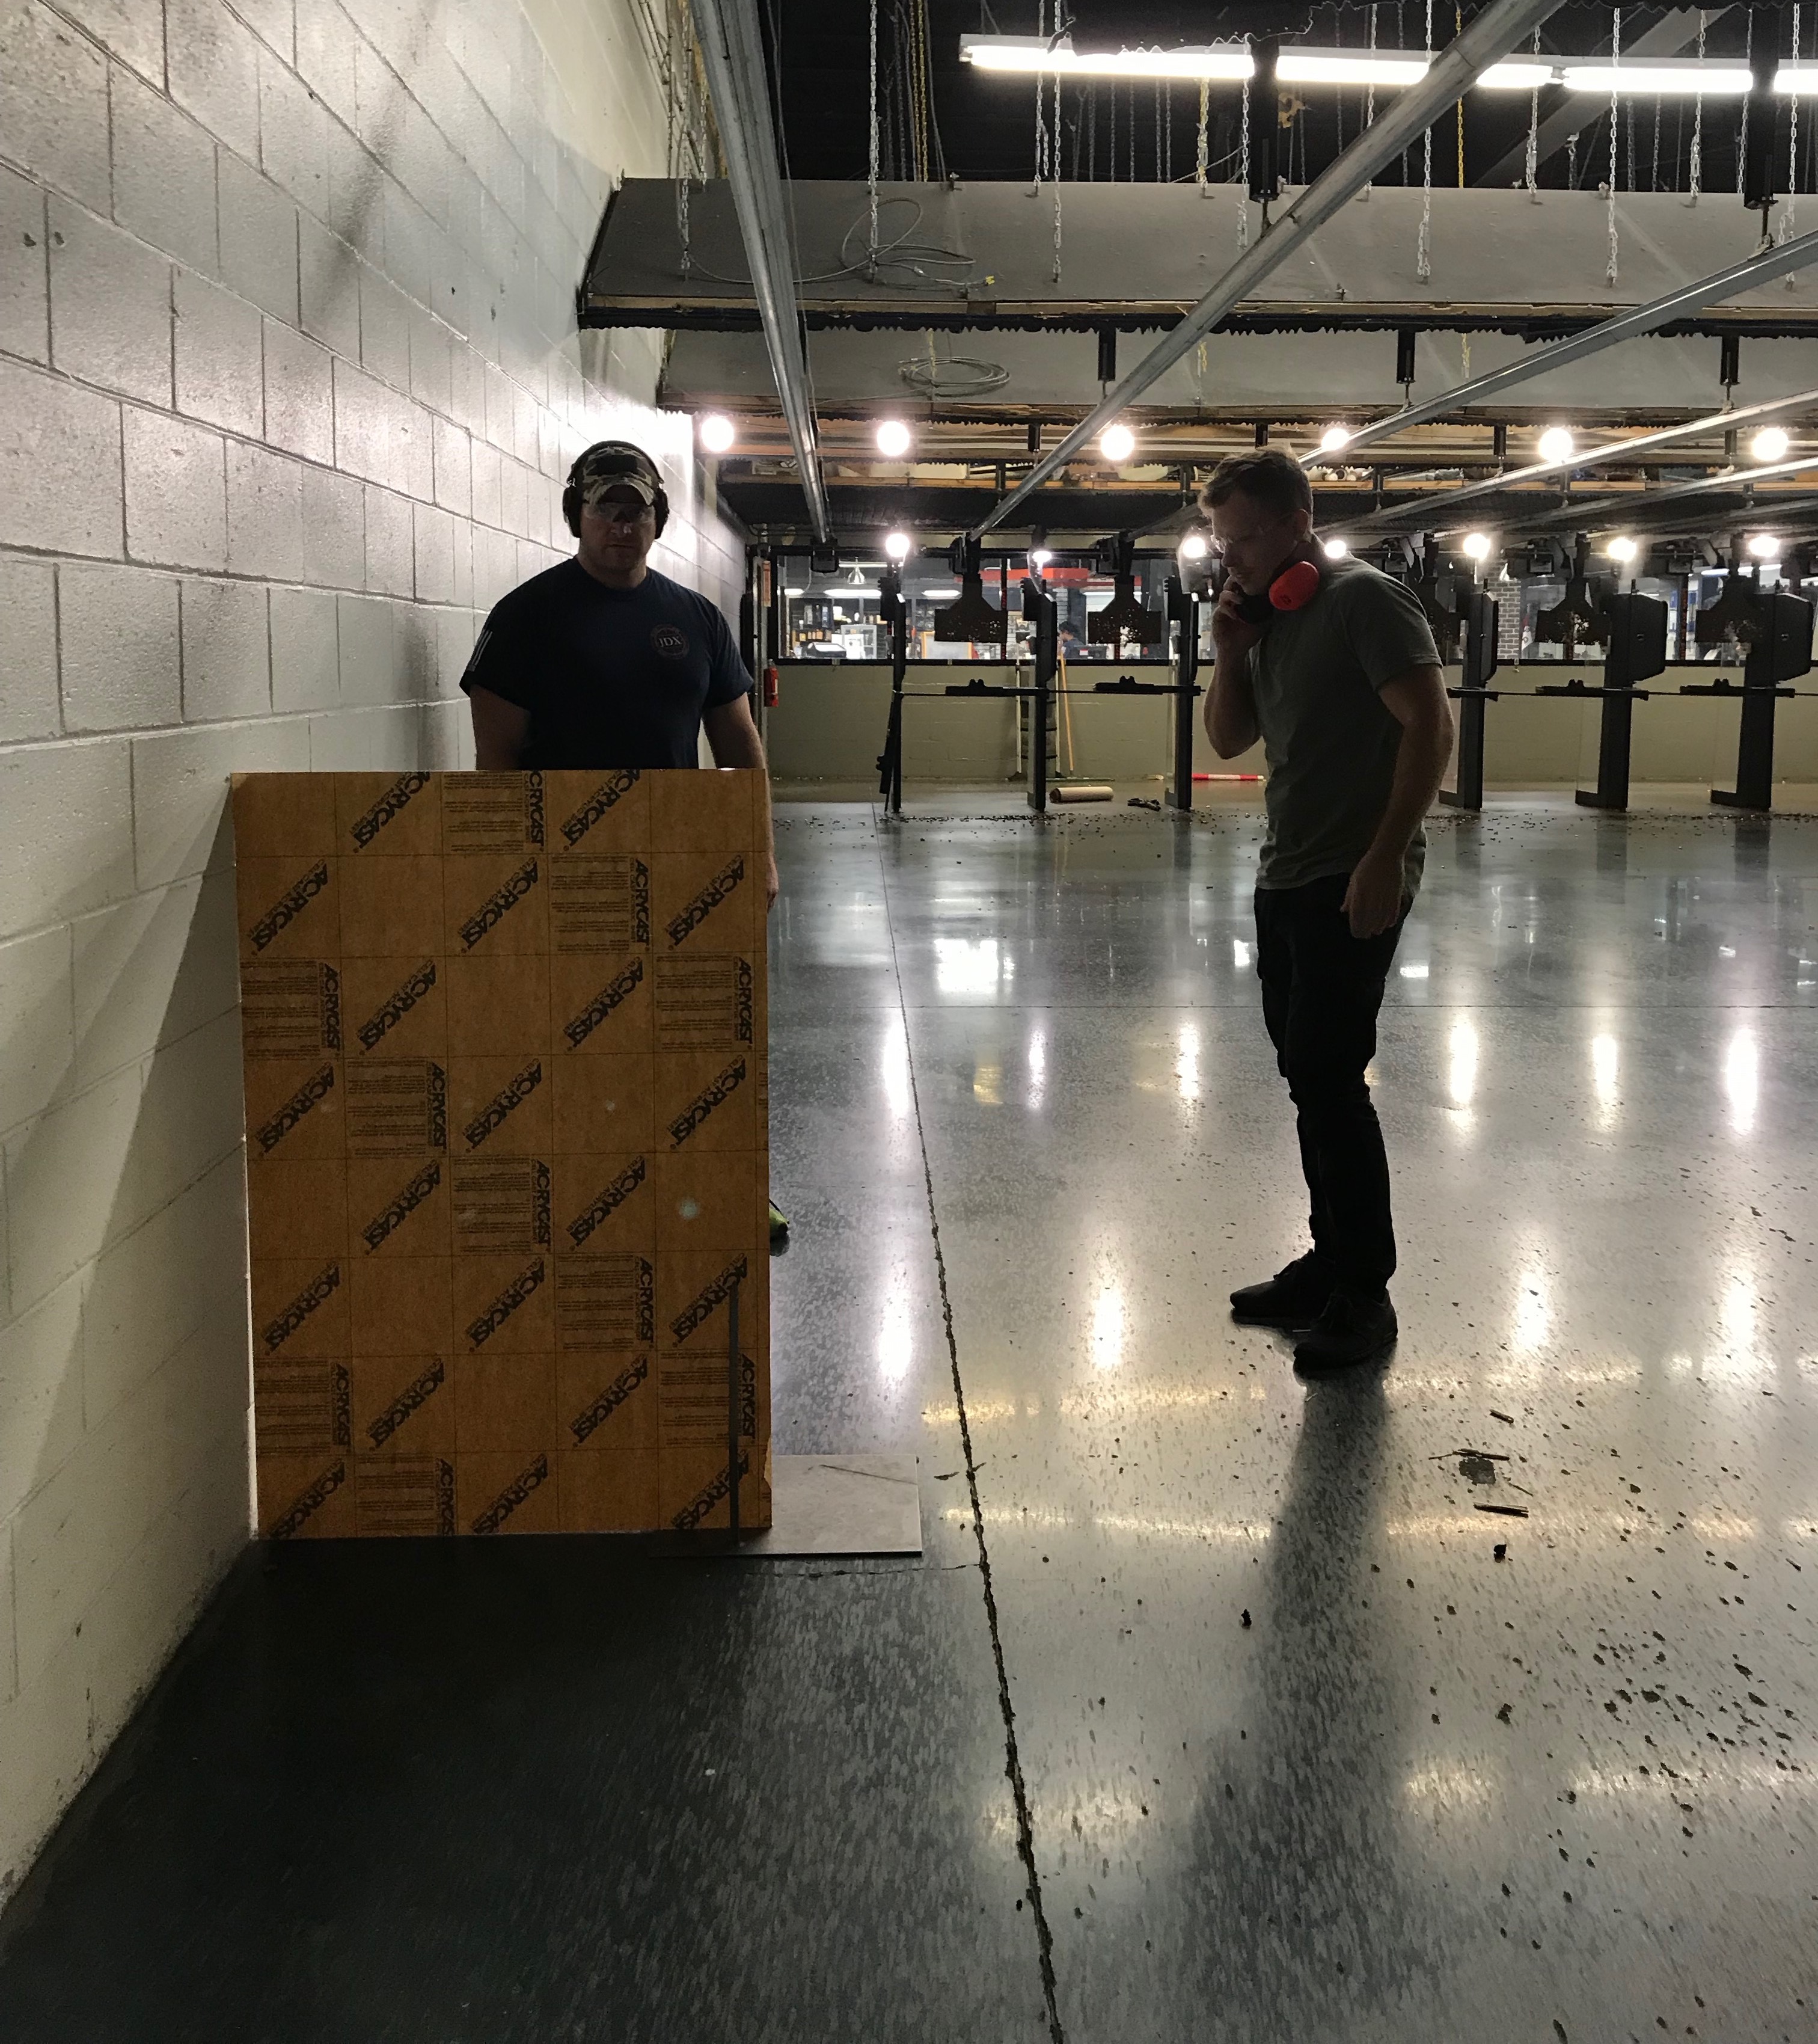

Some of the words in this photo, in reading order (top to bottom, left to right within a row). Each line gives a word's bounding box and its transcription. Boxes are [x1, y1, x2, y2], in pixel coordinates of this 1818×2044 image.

[658, 636, 682, 648] JDX
[529, 769, 544, 846] CRYCAST
[250, 864, 327, 951] ACRYCAST
[461, 861, 537, 949] ACRYCAST
[635, 858, 649, 946] ACRYCAST
[668, 859, 744, 945] ACRYCAST
[325, 963, 340, 1051] ACRYCAST
[359, 964, 435, 1051] ACRYCAST
[566, 960, 643, 1047] ACRYCAST
[739, 957, 753, 1044] ACRYCAST
[257, 1066, 334, 1152] ACRYCAST
[432, 1063, 447, 1149] ACRYCAST
[465, 1061, 541, 1149] ACRYCAST
[670, 1058, 745, 1145] ACRYCAST
[364, 1164, 440, 1250] ACRYCAST
[537, 1159, 551, 1247] ACRYCAST
[569, 1159, 645, 1245] ACRYCAST
[263, 1265, 339, 1351] ACRYCAST
[468, 1261, 544, 1347] ACRYCAST
[640, 1256, 653, 1343] ACRYCAST
[672, 1257, 747, 1343] ACRYCAST
[336, 1363, 350, 1446] ACRYCAST
[369, 1362, 444, 1448] ACRYCAST
[572, 1357, 647, 1443] ACRYCAST
[742, 1353, 755, 1439] ACRYCAST
[441, 1458, 454, 1538] ACRYCAS
